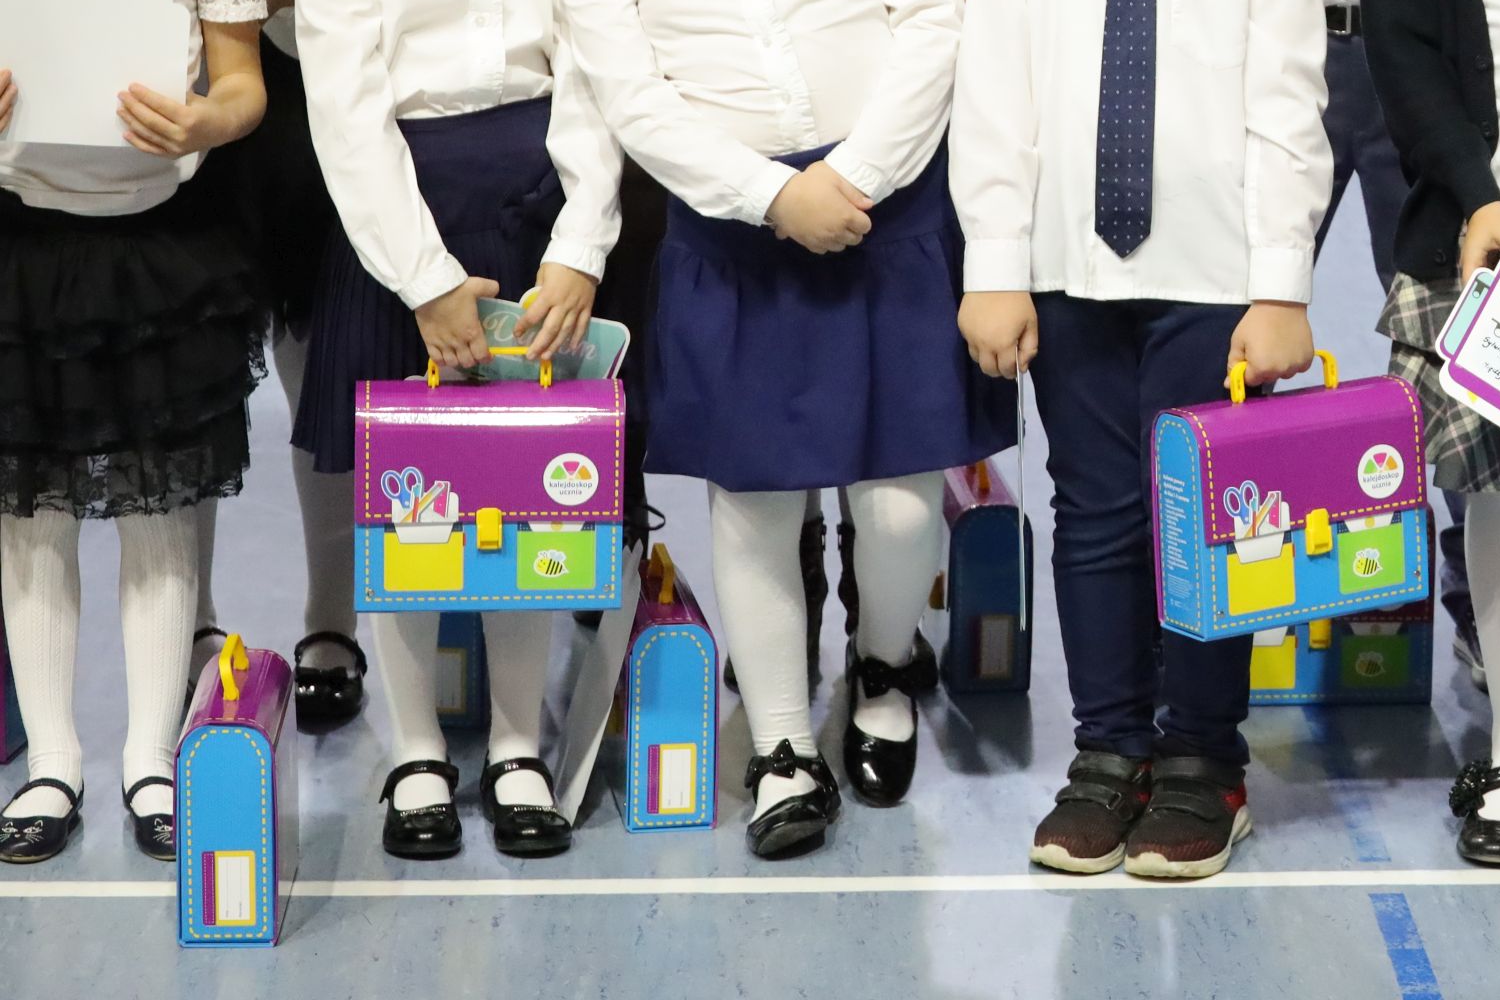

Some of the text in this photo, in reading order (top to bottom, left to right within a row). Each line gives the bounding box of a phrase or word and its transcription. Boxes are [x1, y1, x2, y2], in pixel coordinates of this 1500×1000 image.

[1362, 472, 1400, 483] kalejdoskop
[549, 481, 593, 489] kalejdoskop
[1371, 481, 1392, 489] ucznia
